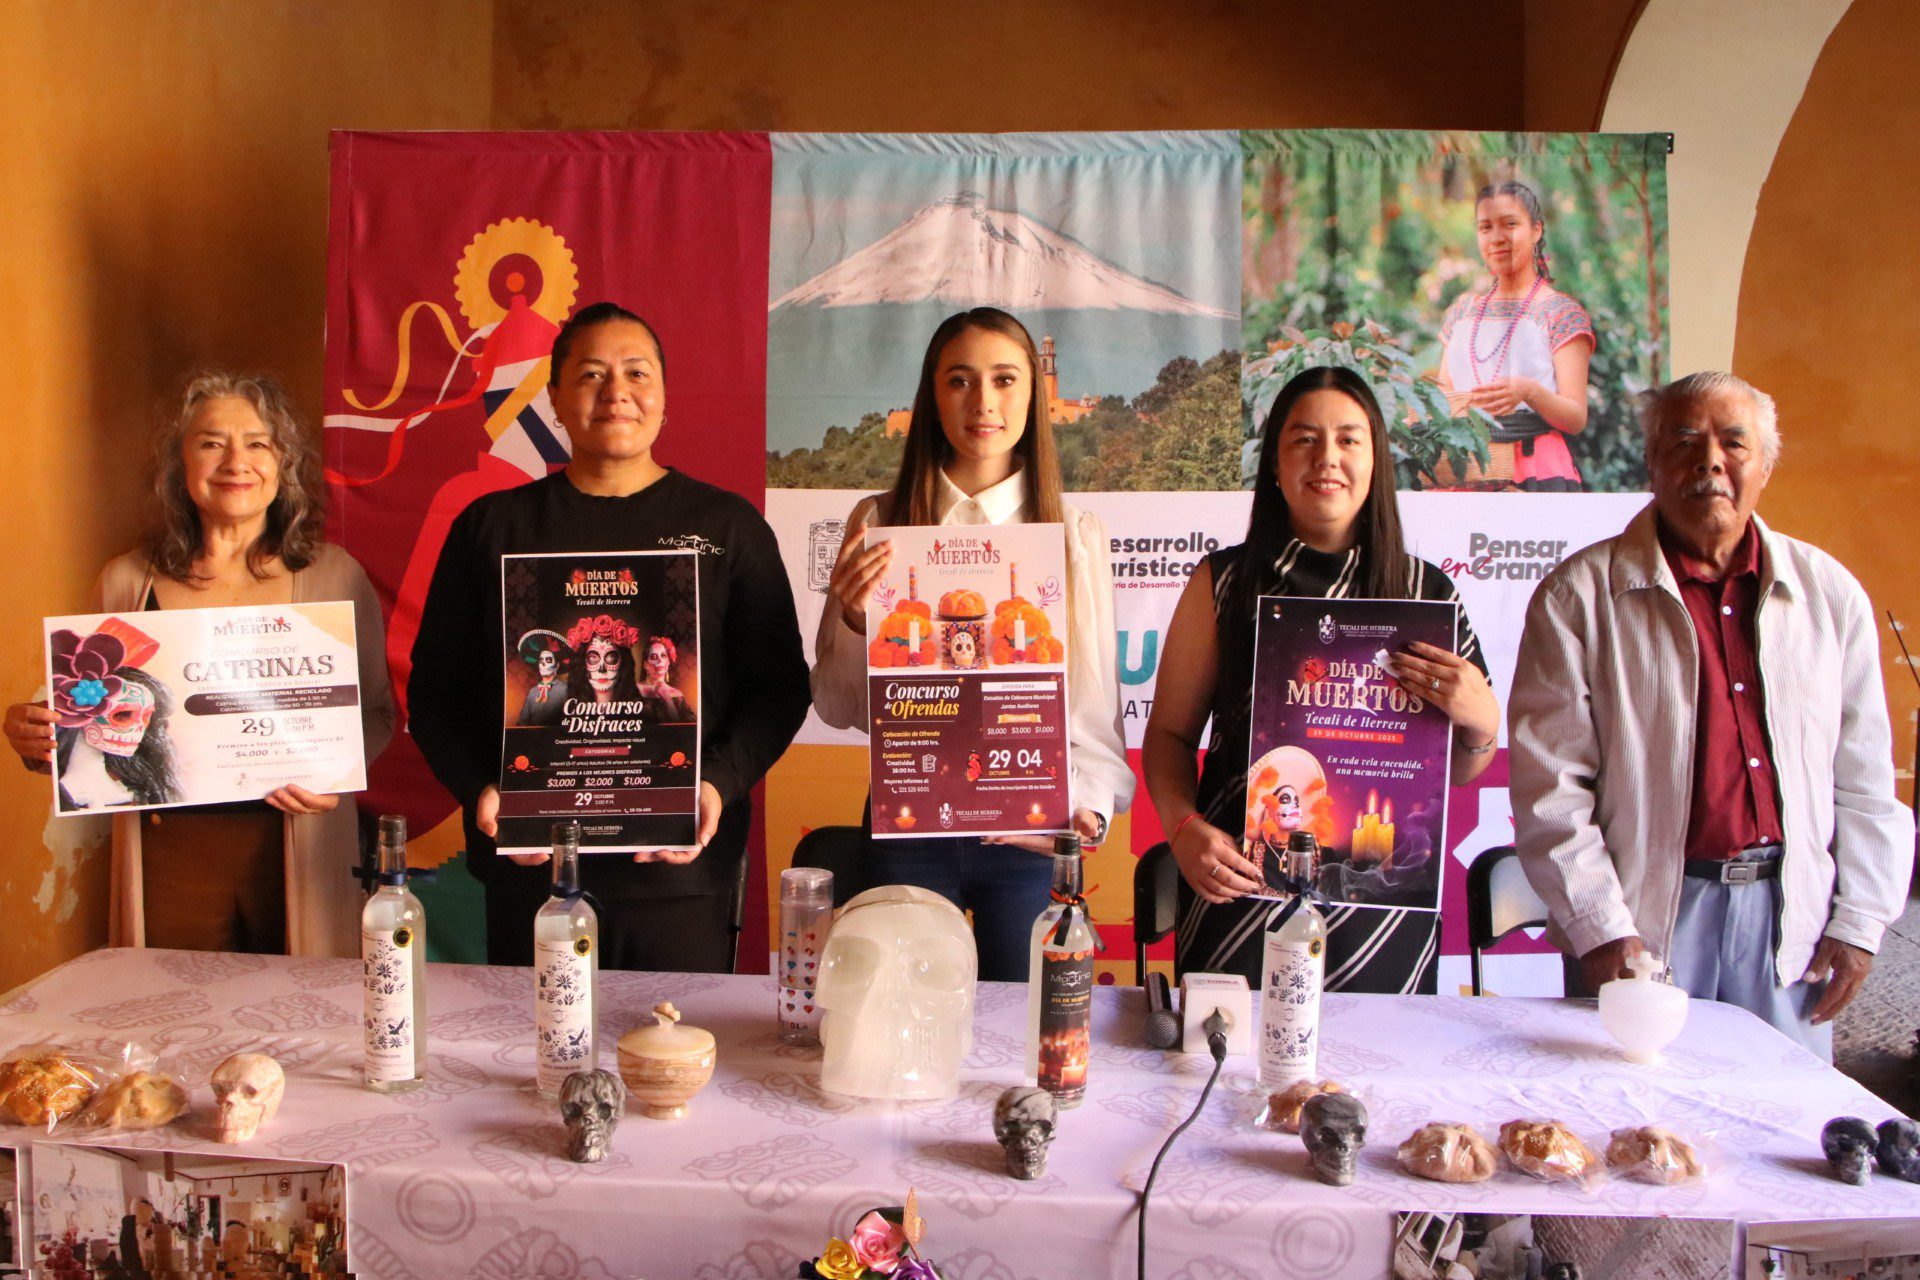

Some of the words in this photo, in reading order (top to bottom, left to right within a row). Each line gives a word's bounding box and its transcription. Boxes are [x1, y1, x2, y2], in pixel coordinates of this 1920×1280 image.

[948, 537, 964, 548] DÍA
[966, 539, 979, 548] DE
[1109, 532, 1219, 553] esarrollo
[1468, 532, 1568, 558] Pensar
[926, 550, 1001, 565] MUERTOS
[587, 569, 602, 581] DÍA
[604, 570, 617, 580] DE
[1441, 557, 1482, 579] en
[1472, 556, 1562, 580] Grand
[565, 581, 639, 597] MUERTOS
[1128, 581, 1138, 589] de
[1140, 581, 1180, 589] Desarrollo
[214, 622, 292, 637] MUERTOS
[282, 645, 301, 654] DE
[183, 654, 335, 683] CATRINAS
[1329, 659, 1358, 678] DÍA
[1362, 663, 1384, 681] DE
[261, 689, 293, 697] MATERIAL
[885, 682, 960, 700] Concurso
[1286, 679, 1424, 715] MUERTOS
[563, 698, 644, 716] Concurso
[883, 701, 893, 710] de
[891, 699, 960, 720] Ofrendas
[241, 717, 275, 737] 29
[561, 717, 570, 726] de
[568, 716, 643, 736] Disfraces
[1304, 711, 1341, 726] Tecali
[1343, 714, 1357, 728] de
[1360, 716, 1408, 731] Herrera
[989, 749, 1011, 769] 29
[1017, 748, 1042, 768] 04
[1327, 755, 1338, 764] En
[1340, 756, 1359, 766] cada
[1361, 757, 1378, 766] vela
[547, 778, 576, 788] $3,000
[585, 777, 614, 787] $2,000
[623, 776, 652, 786] $1,000
[1335, 767, 1351, 776] una
[1353, 768, 1389, 778] memoria
[1391, 769, 1415, 780] brilla
[574, 792, 593, 806] 29
